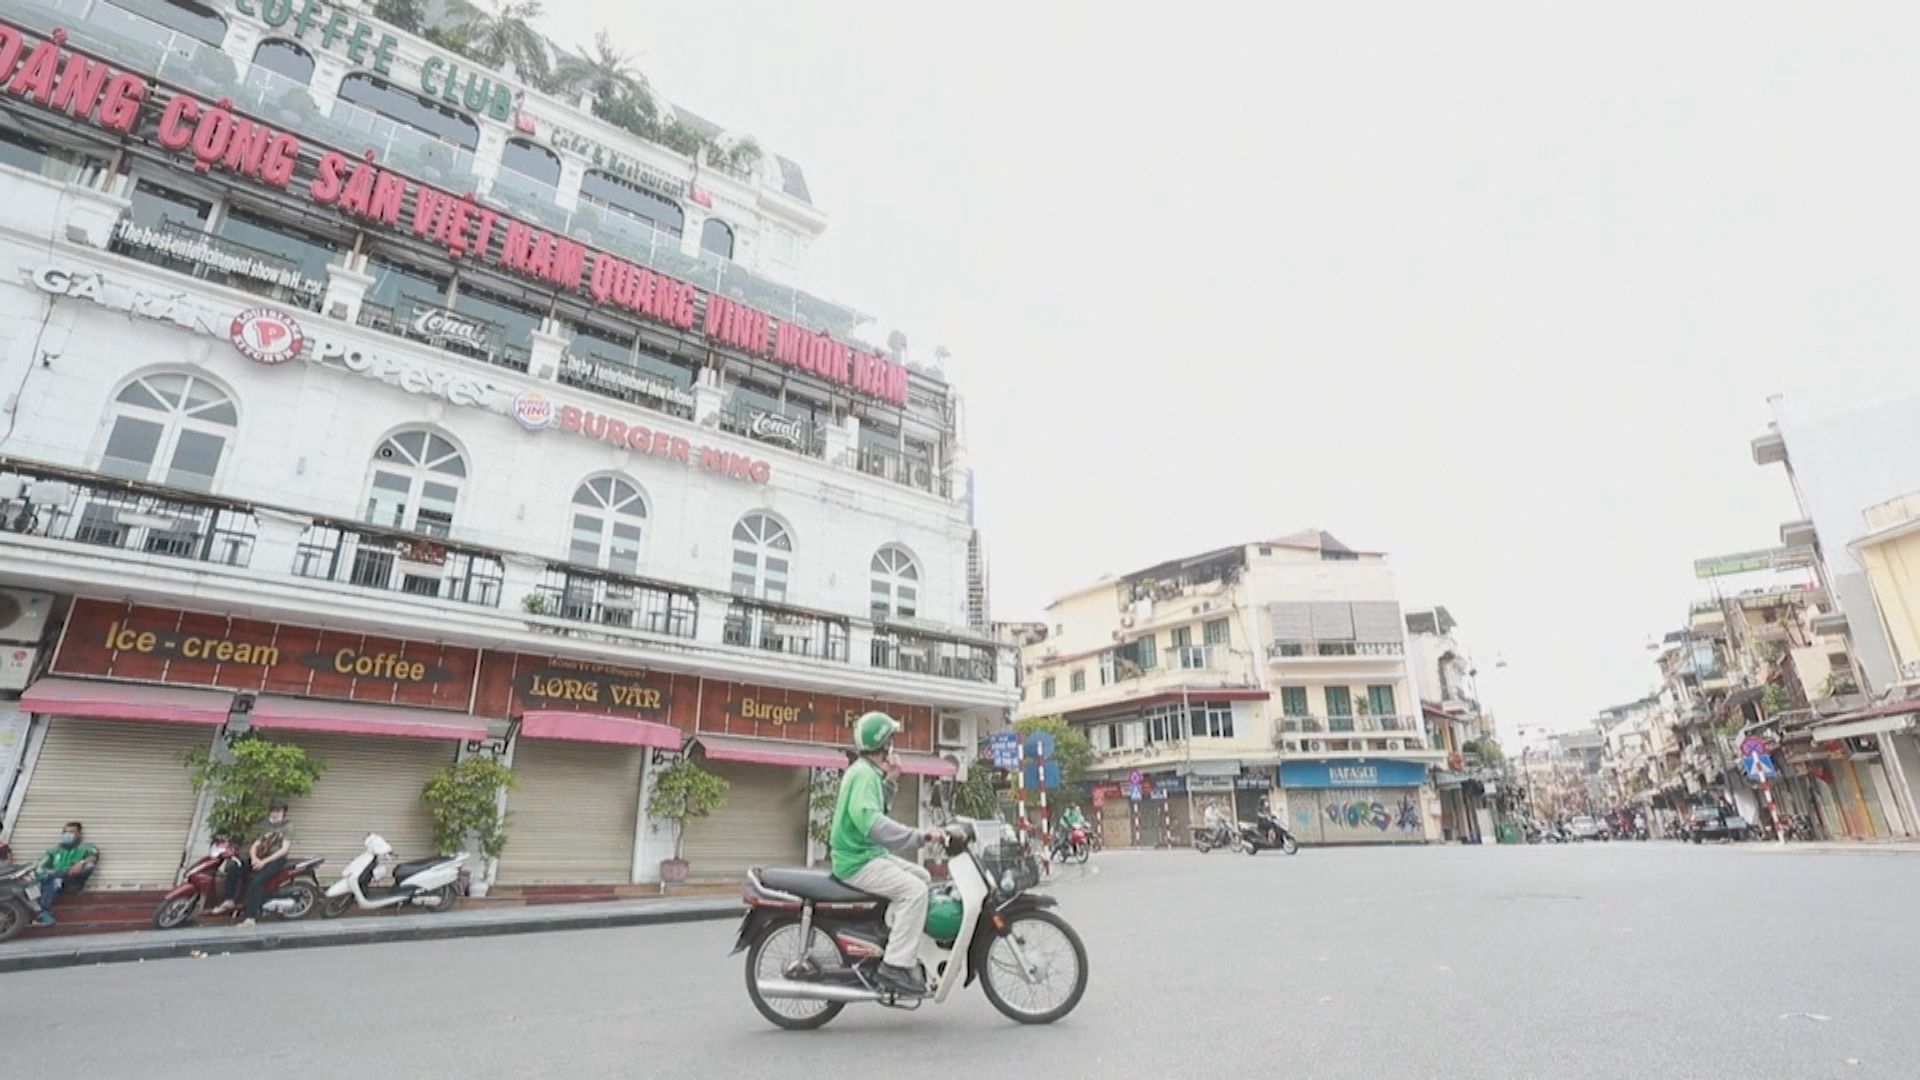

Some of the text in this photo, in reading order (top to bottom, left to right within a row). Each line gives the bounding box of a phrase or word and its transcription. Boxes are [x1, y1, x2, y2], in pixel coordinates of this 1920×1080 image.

[420, 55, 513, 123] CLUB
[608, 151, 685, 199] Restaurant
[119, 219, 143, 243] The
[250, 259, 281, 283] show
[157, 96, 300, 189] CỘNG
[310, 149, 407, 226] SẢN
[412, 185, 499, 260] VIỆT
[500, 219, 587, 290] NAM
[590, 254, 695, 331] QUANG
[704, 293, 770, 355] VINH
[773, 320, 850, 386] MUÔN
[255, 320, 286, 347] P
[517, 405, 551, 417] KING
[560, 404, 771, 485] BURGER KING
[105, 621, 157, 653] Ice
[181, 636, 280, 667] cream
[333, 648, 426, 681] Coffee
[529, 674, 599, 703] LONG
[741, 698, 801, 726] Burger
